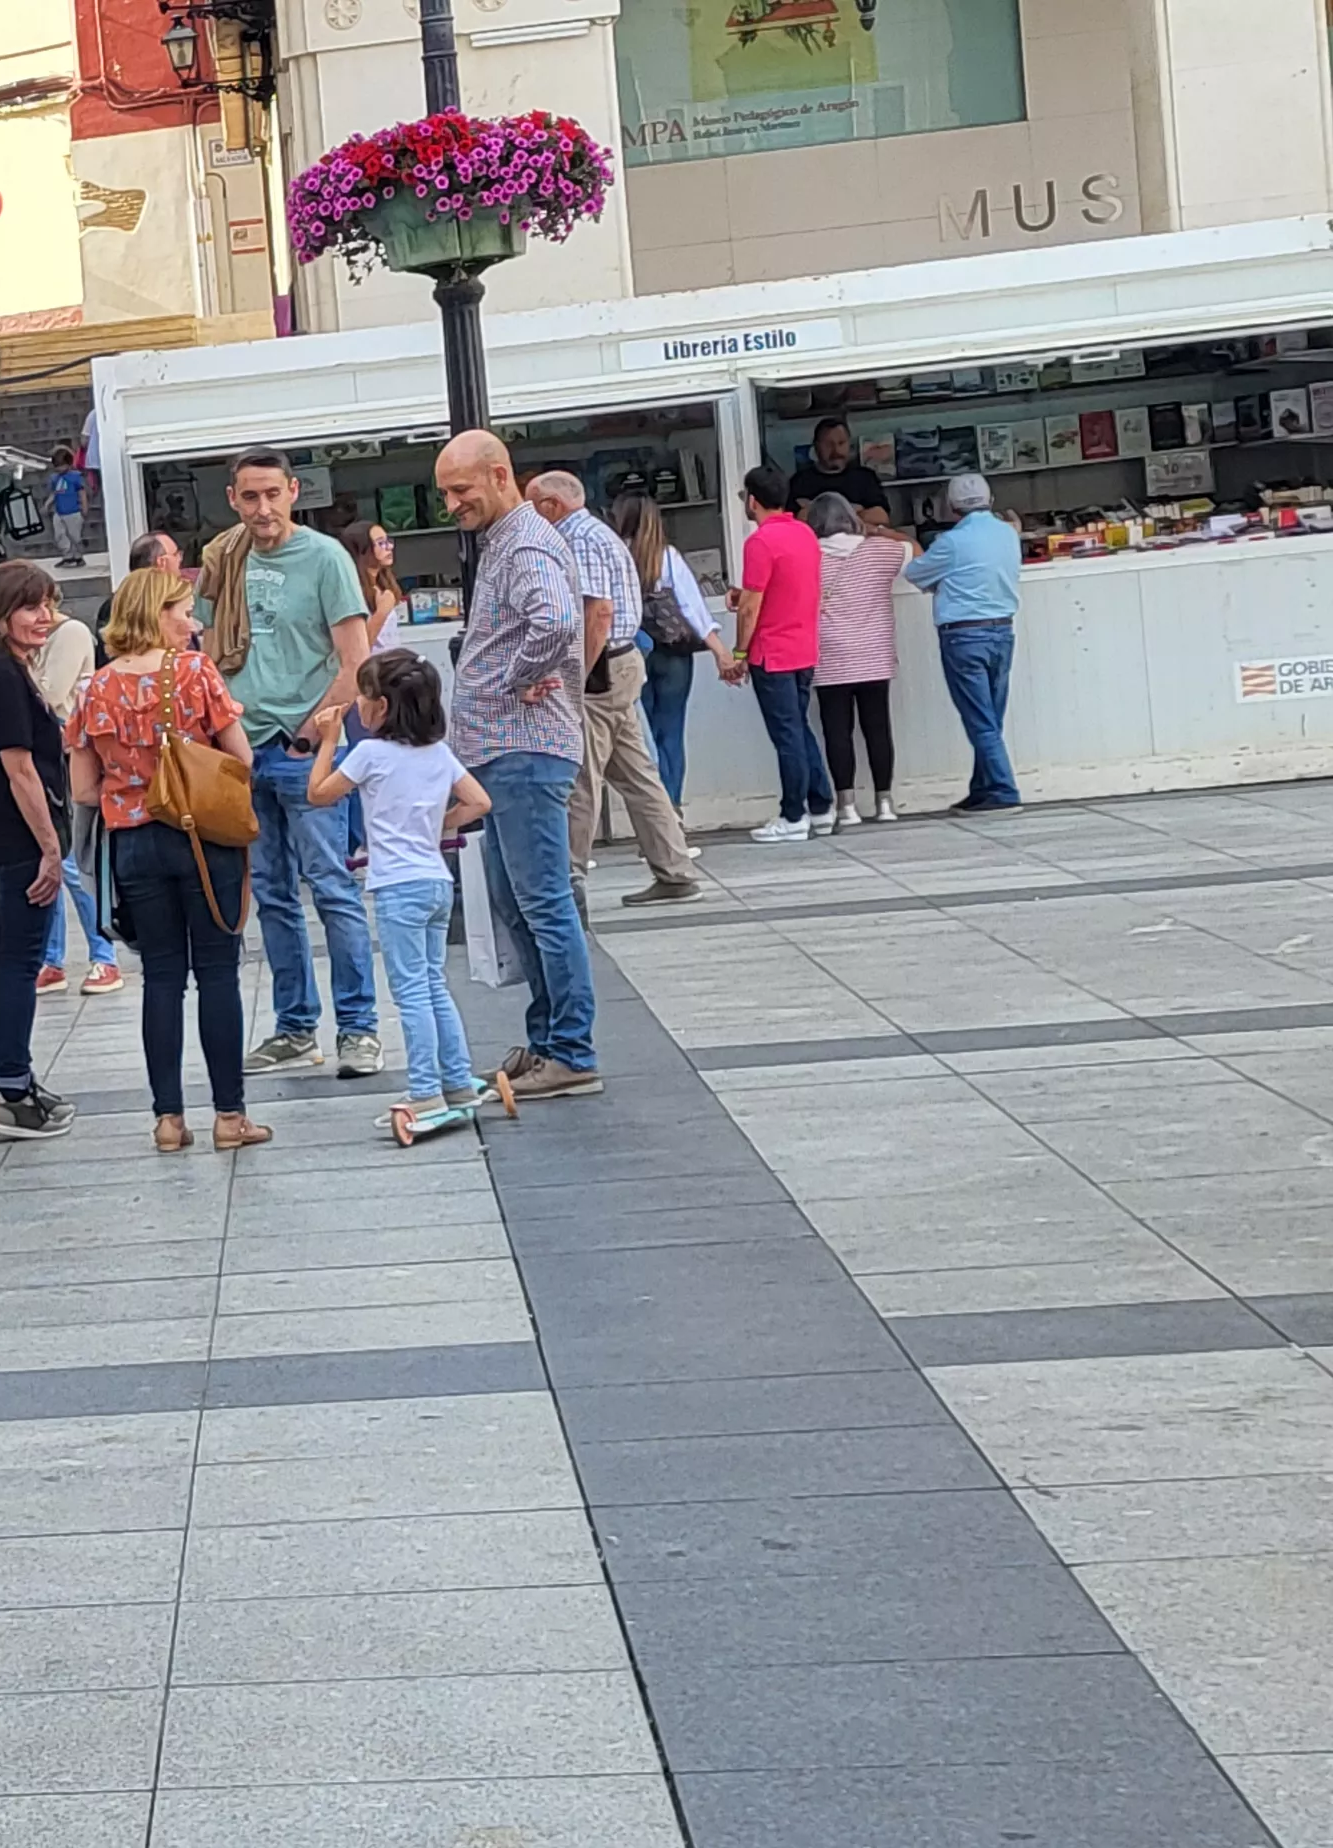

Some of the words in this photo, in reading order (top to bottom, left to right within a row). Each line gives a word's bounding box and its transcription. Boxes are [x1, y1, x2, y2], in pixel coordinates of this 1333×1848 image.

[621, 120, 688, 148] MPA
[936, 173, 1125, 243] MUS
[743, 329, 797, 351] Estilo
[1279, 679, 1305, 695] DE
